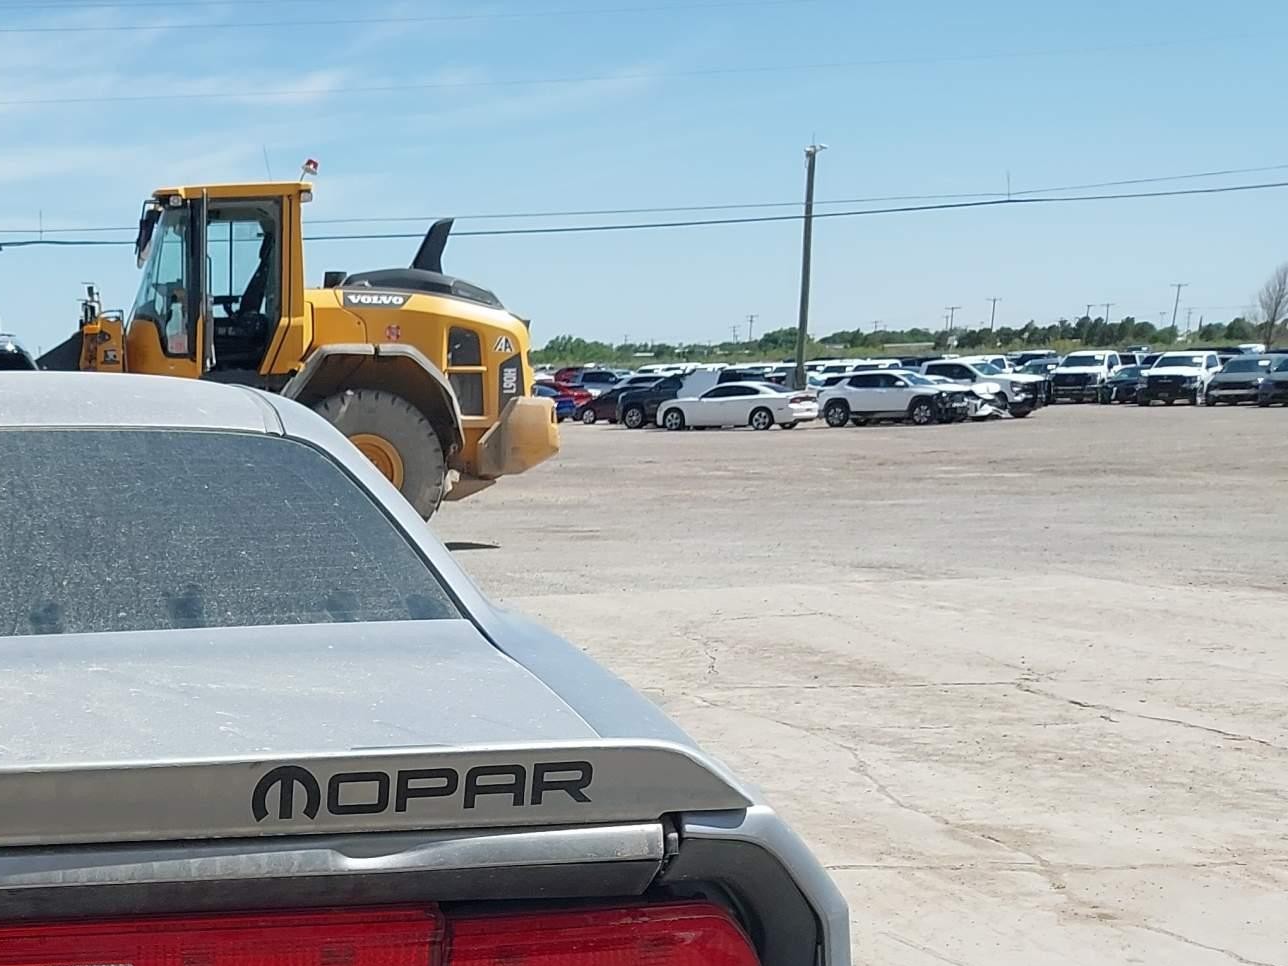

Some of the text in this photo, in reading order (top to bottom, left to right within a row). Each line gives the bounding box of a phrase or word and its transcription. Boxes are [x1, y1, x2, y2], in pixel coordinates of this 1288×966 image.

[347, 294, 404, 305] VOLVO
[502, 367, 517, 394] L90H
[251, 760, 594, 822] MOPAR
